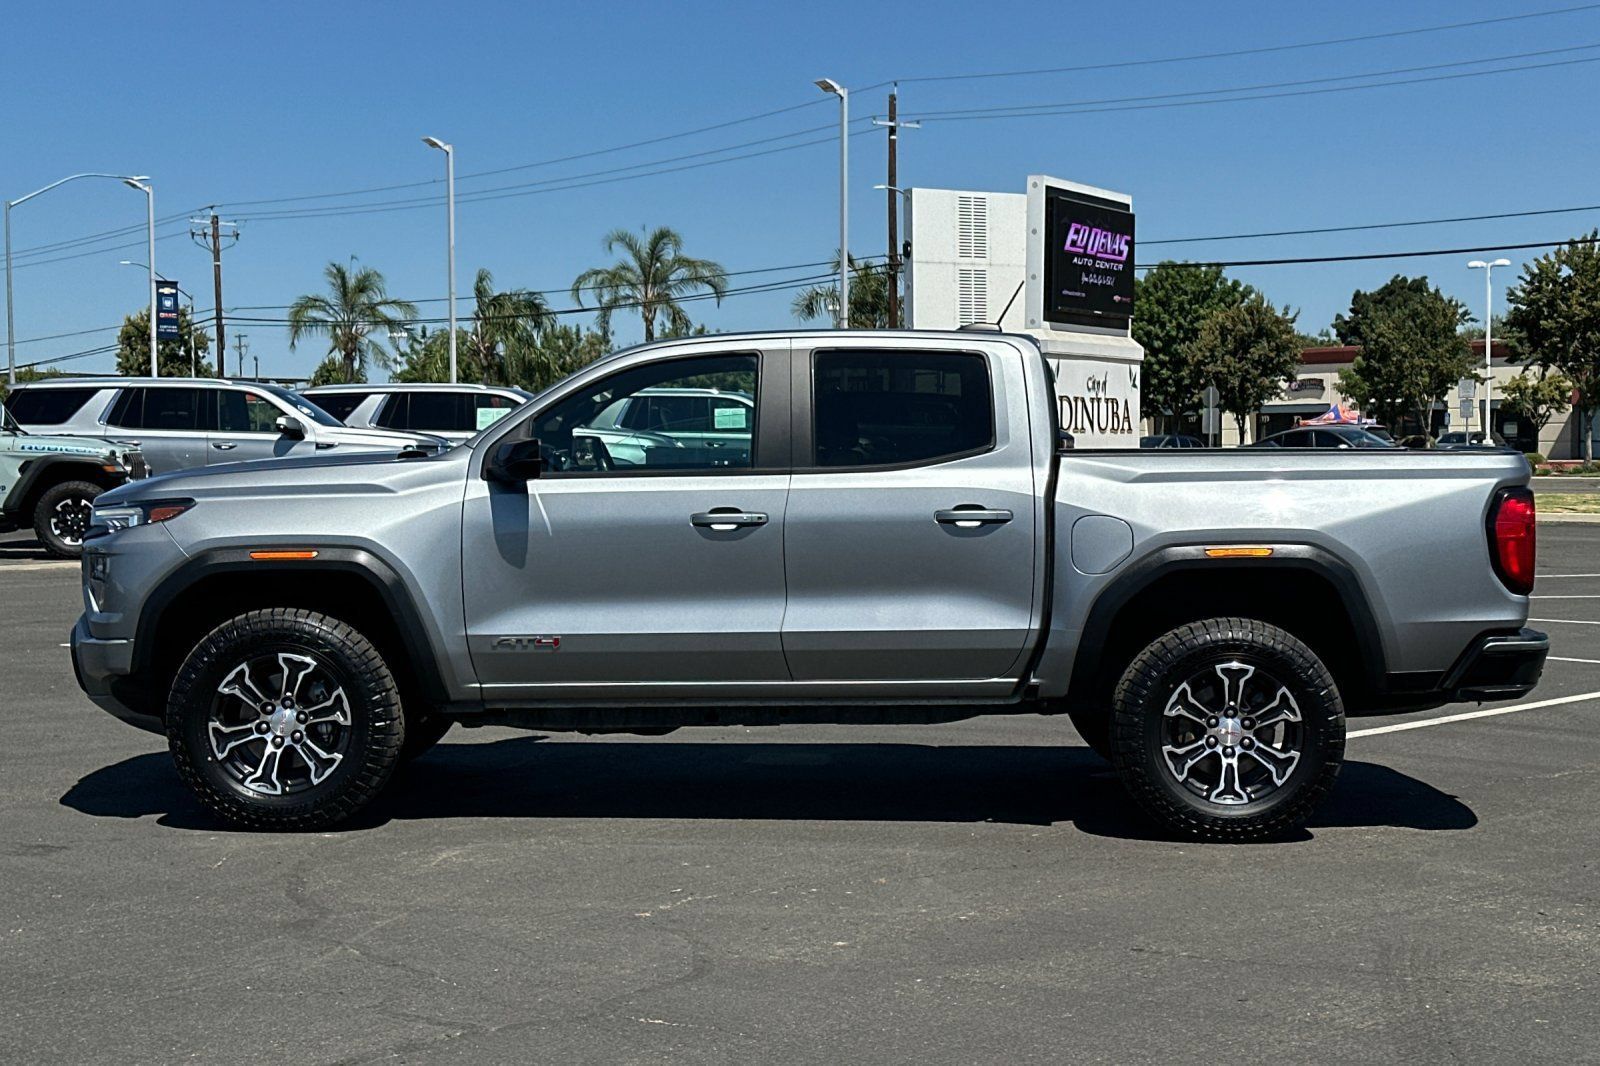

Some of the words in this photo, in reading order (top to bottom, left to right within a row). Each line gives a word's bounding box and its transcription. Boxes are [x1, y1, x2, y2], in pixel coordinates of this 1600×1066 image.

[1072, 257, 1093, 266] AUTO
[1095, 260, 1123, 271] CENTER
[1086, 375, 1101, 397] City
[1101, 371, 1108, 398] of
[1058, 395, 1133, 434] DINUBA
